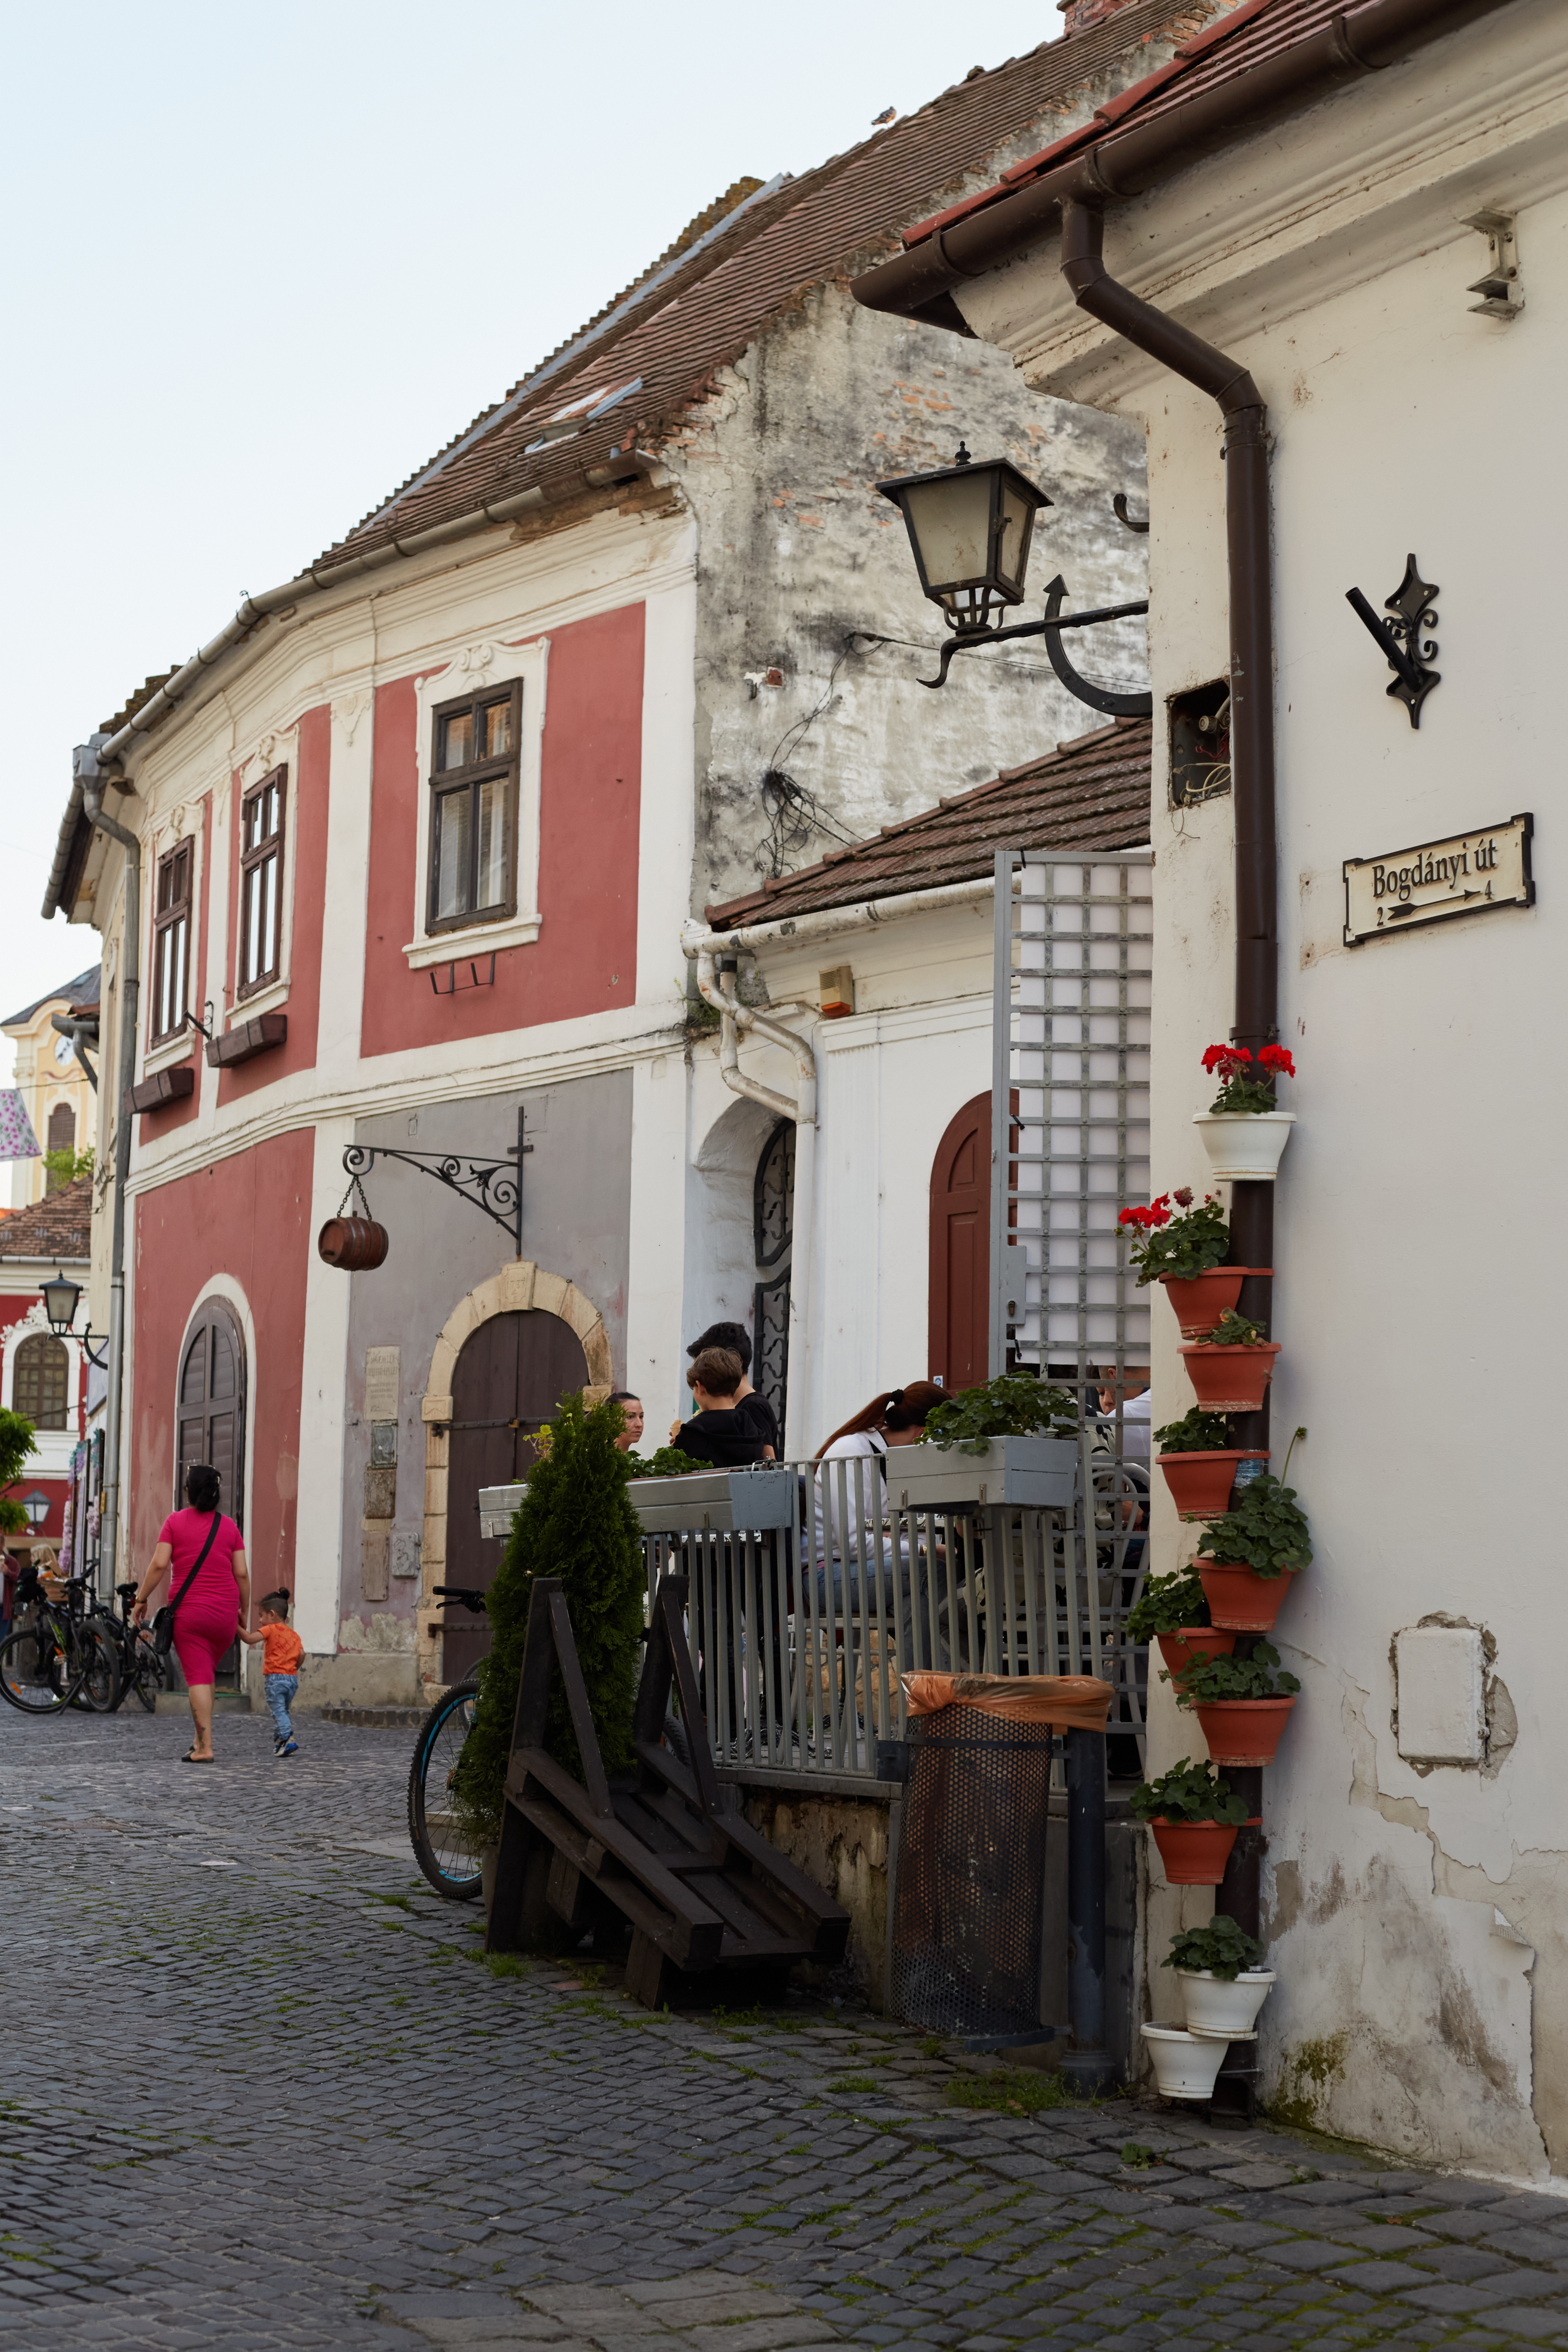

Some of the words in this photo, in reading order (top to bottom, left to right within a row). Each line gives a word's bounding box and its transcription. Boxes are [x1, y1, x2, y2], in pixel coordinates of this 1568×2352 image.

[1373, 841, 1469, 901] Bogdányi
[1474, 838, 1497, 871] út
[1377, 907, 1384, 926] 2
[1485, 880, 1492, 900] 4
